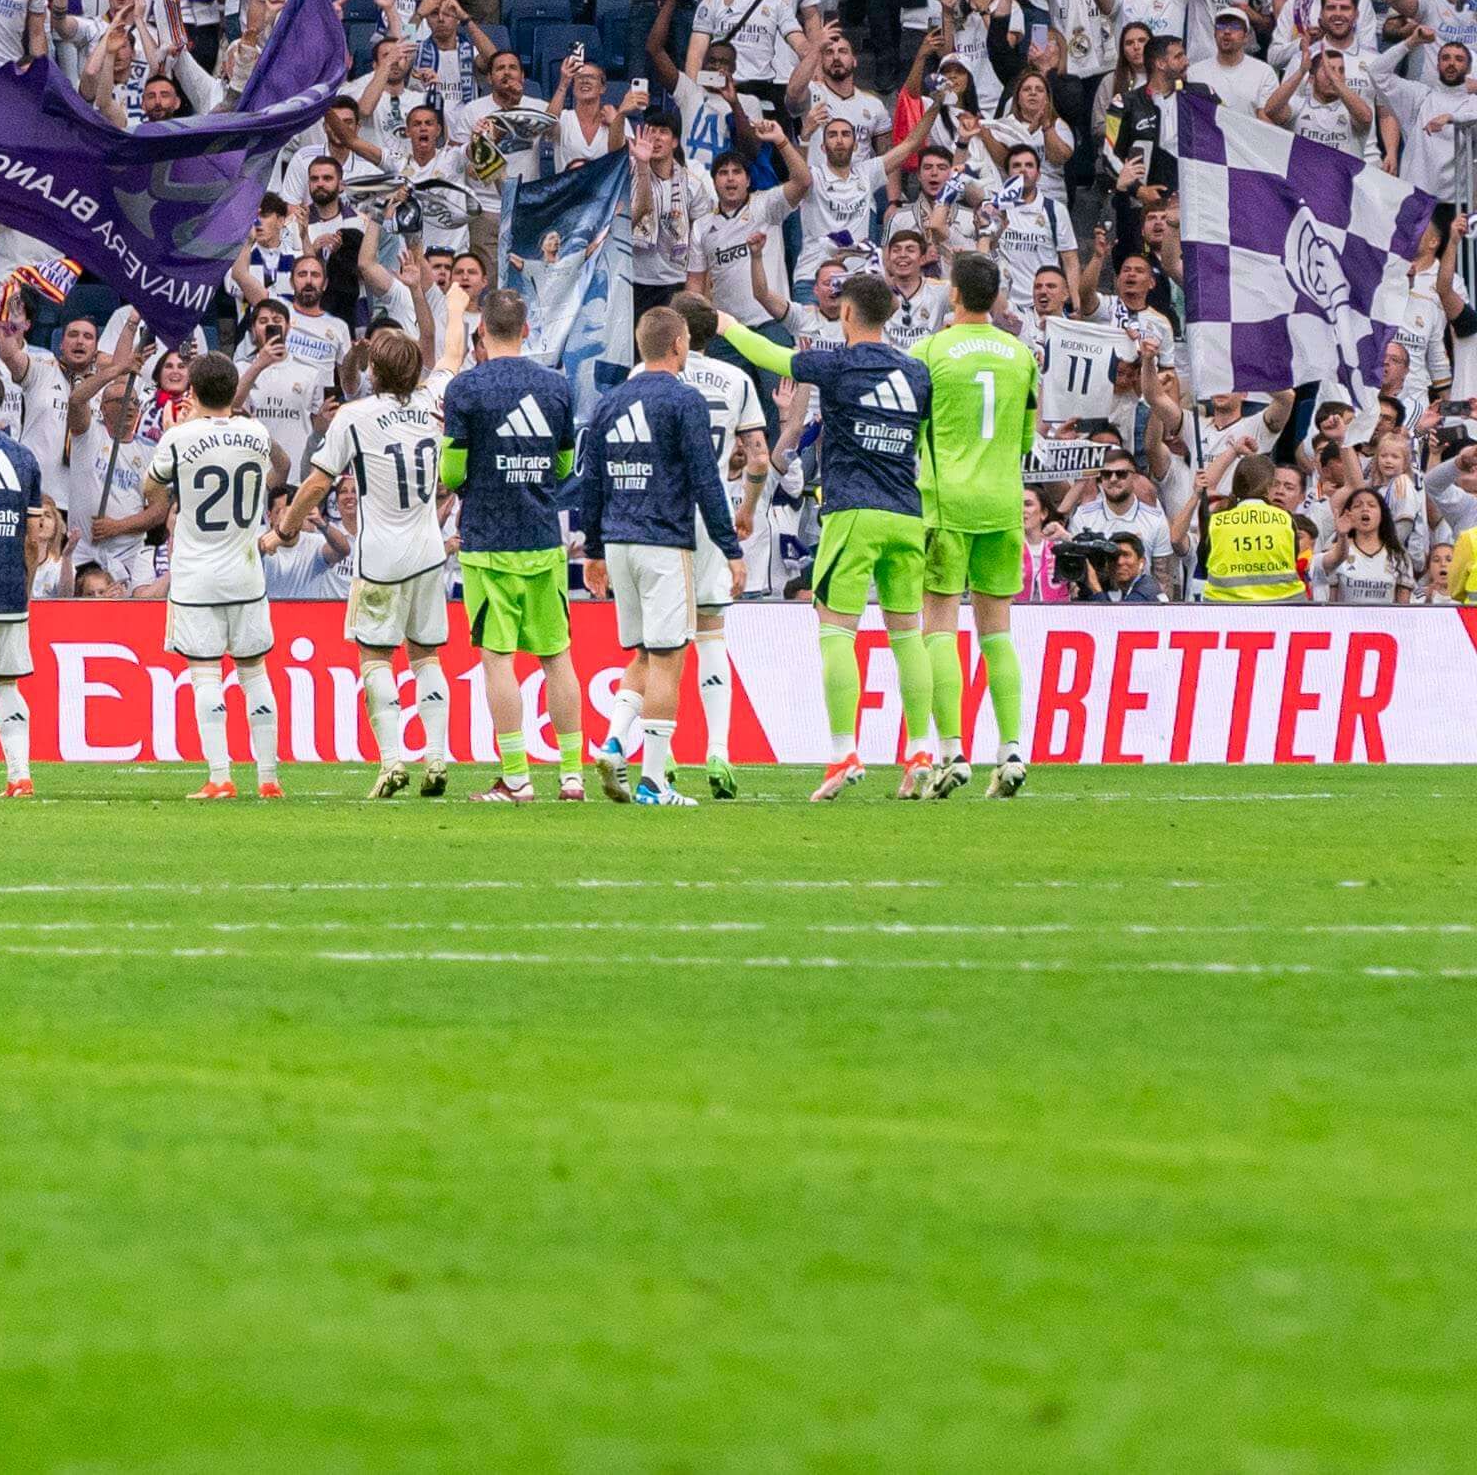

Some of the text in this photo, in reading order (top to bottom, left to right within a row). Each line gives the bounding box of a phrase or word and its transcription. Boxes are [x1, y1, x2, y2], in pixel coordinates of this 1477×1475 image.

[720, 19, 769, 33] Emates
[1003, 229, 1047, 243] mirates
[716, 242, 749, 265] teka
[888, 326, 932, 338] mirates
[288, 334, 334, 353] mirates
[948, 338, 1016, 359] COURTOIS
[1060, 338, 1104, 354] RODRYGO
[681, 371, 731, 393] LVERDE
[1067, 354, 1092, 394] 11
[256, 406, 301, 419] mirates
[973, 370, 996, 439] 1
[854, 421, 914, 441] Emirates
[182, 433, 220, 463] FRAN
[495, 454, 551, 470] Emirates
[1021, 445, 1106, 474] LLINGHAM
[385, 438, 437, 509] 10
[195, 463, 262, 531] 20
[1215, 506, 1287, 526] SEGURIDAD
[1232, 534, 1275, 552] 1513
[1346, 577, 1392, 590] Emirates
[1032, 630, 1398, 763] BETTER
